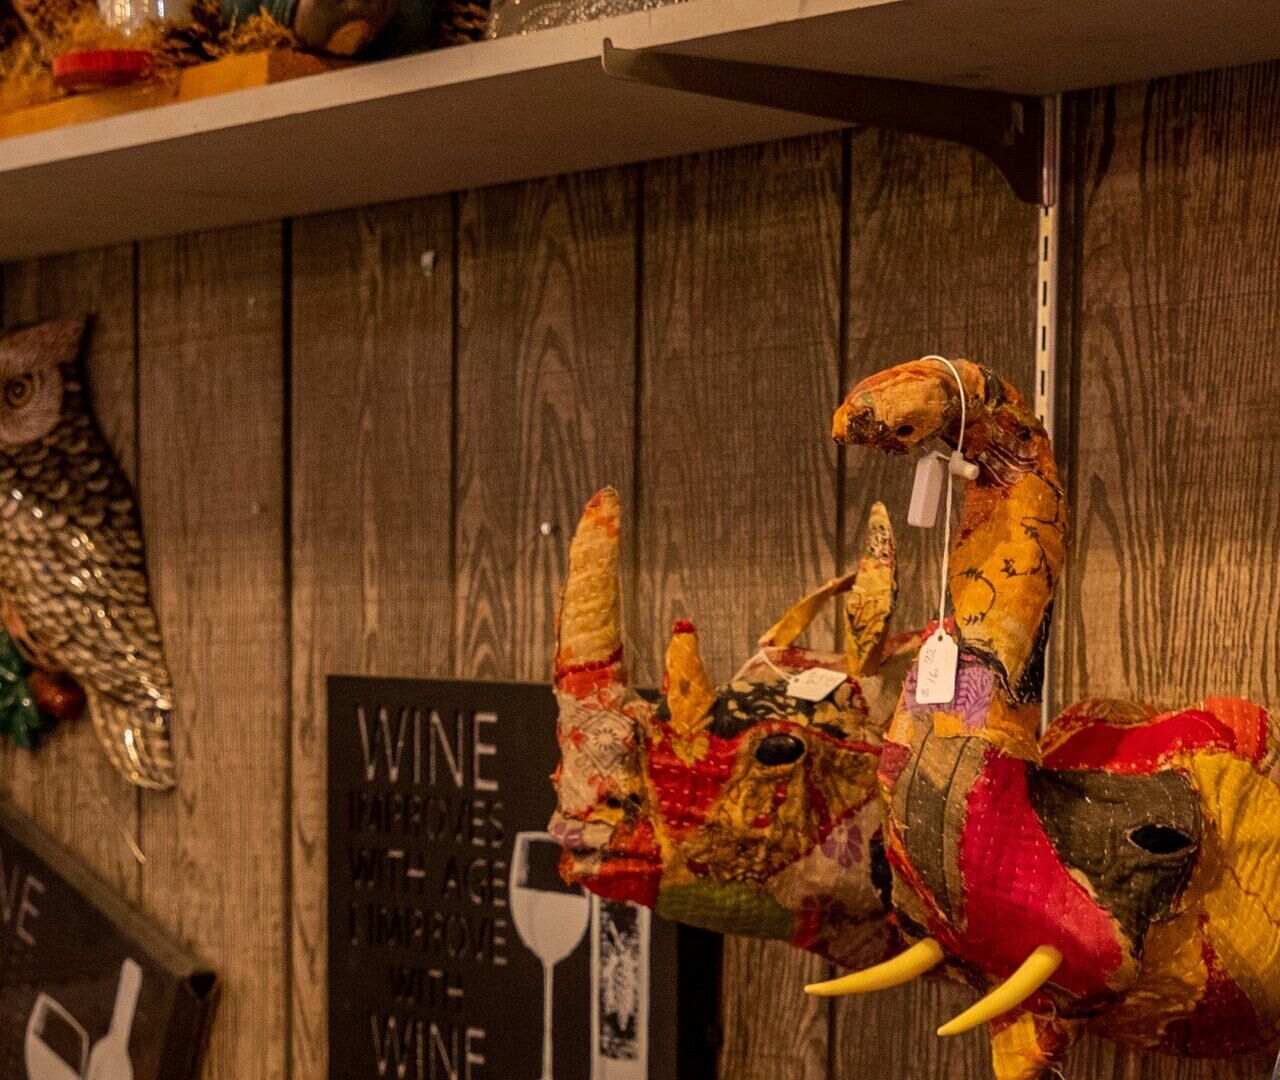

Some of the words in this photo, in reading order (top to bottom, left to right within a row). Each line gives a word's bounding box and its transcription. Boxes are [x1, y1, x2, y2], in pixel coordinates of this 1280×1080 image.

[357, 706, 500, 792] WINE
[349, 845, 426, 894] WITH
[441, 856, 508, 908] AGE
